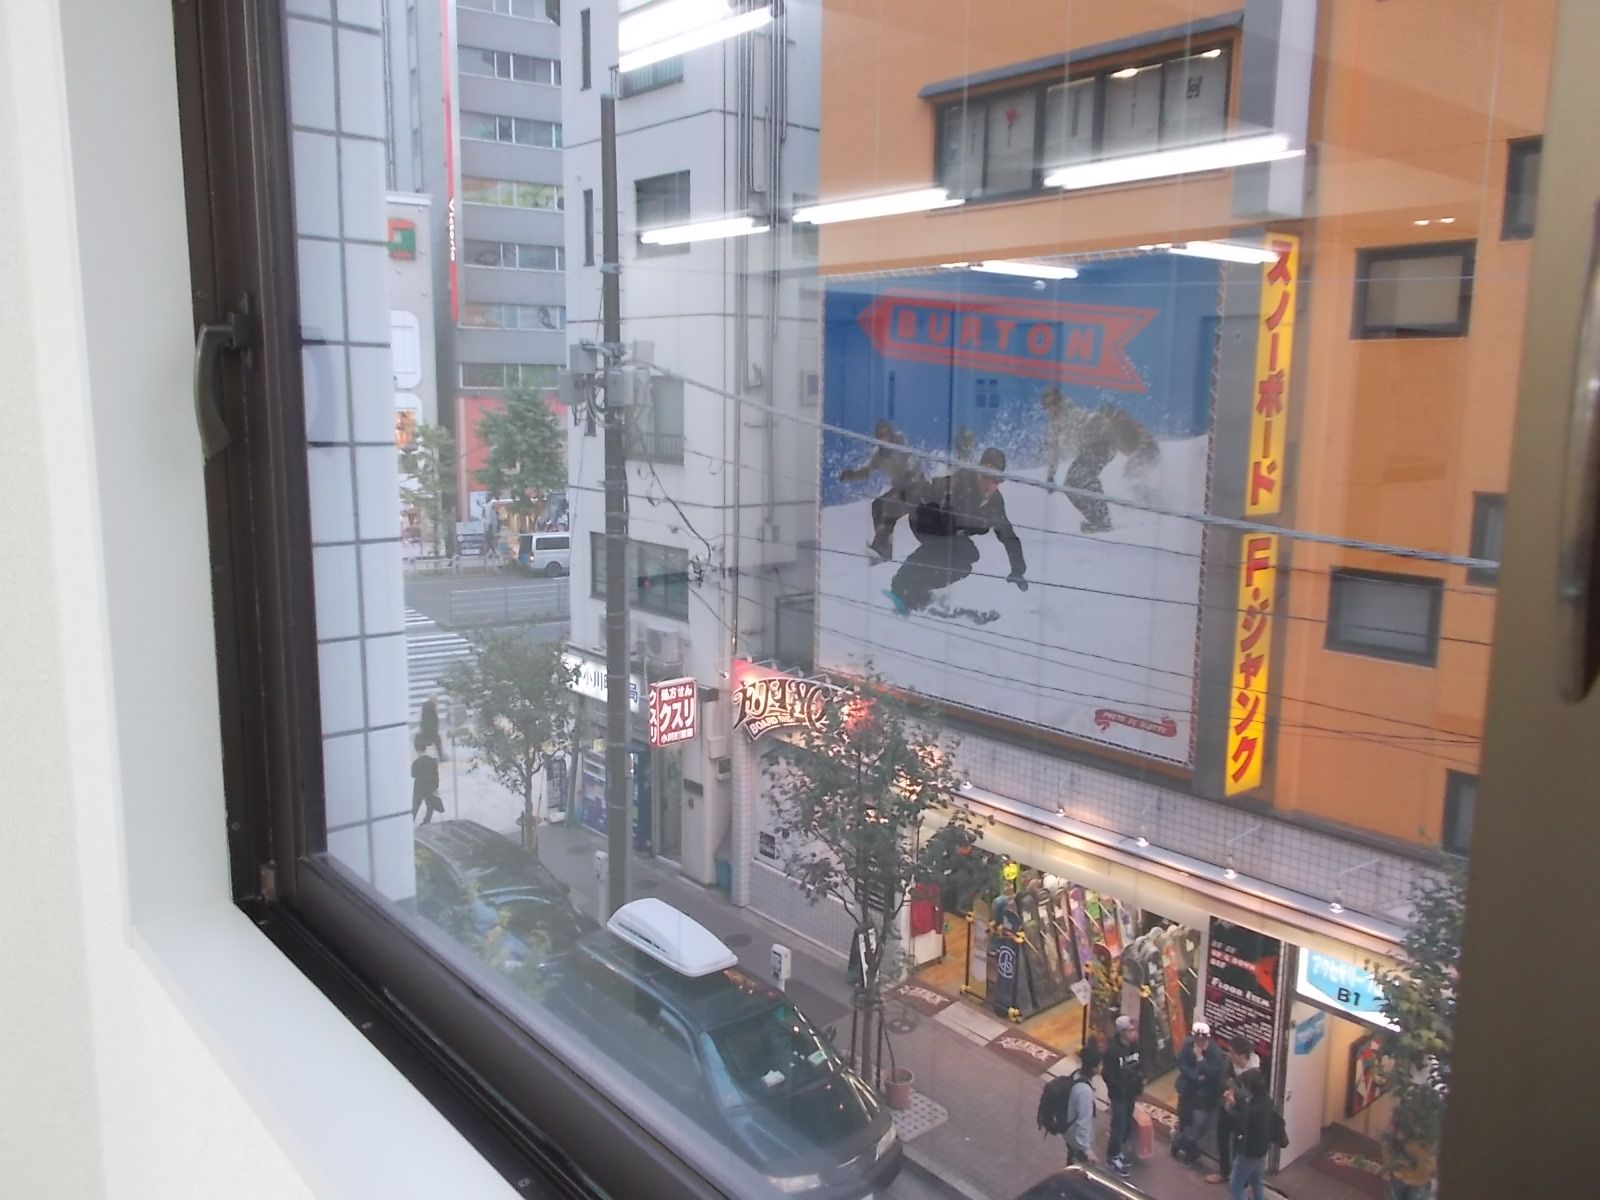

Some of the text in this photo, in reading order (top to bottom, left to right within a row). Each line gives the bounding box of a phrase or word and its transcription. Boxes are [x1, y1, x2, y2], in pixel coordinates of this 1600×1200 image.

[896, 309, 1095, 361] BURTON
[1251, 239, 1293, 506] スノーボード
[660, 698, 695, 733] クスリ
[749, 715, 778, 735] BOARD
[1337, 986, 1361, 1007] B1
